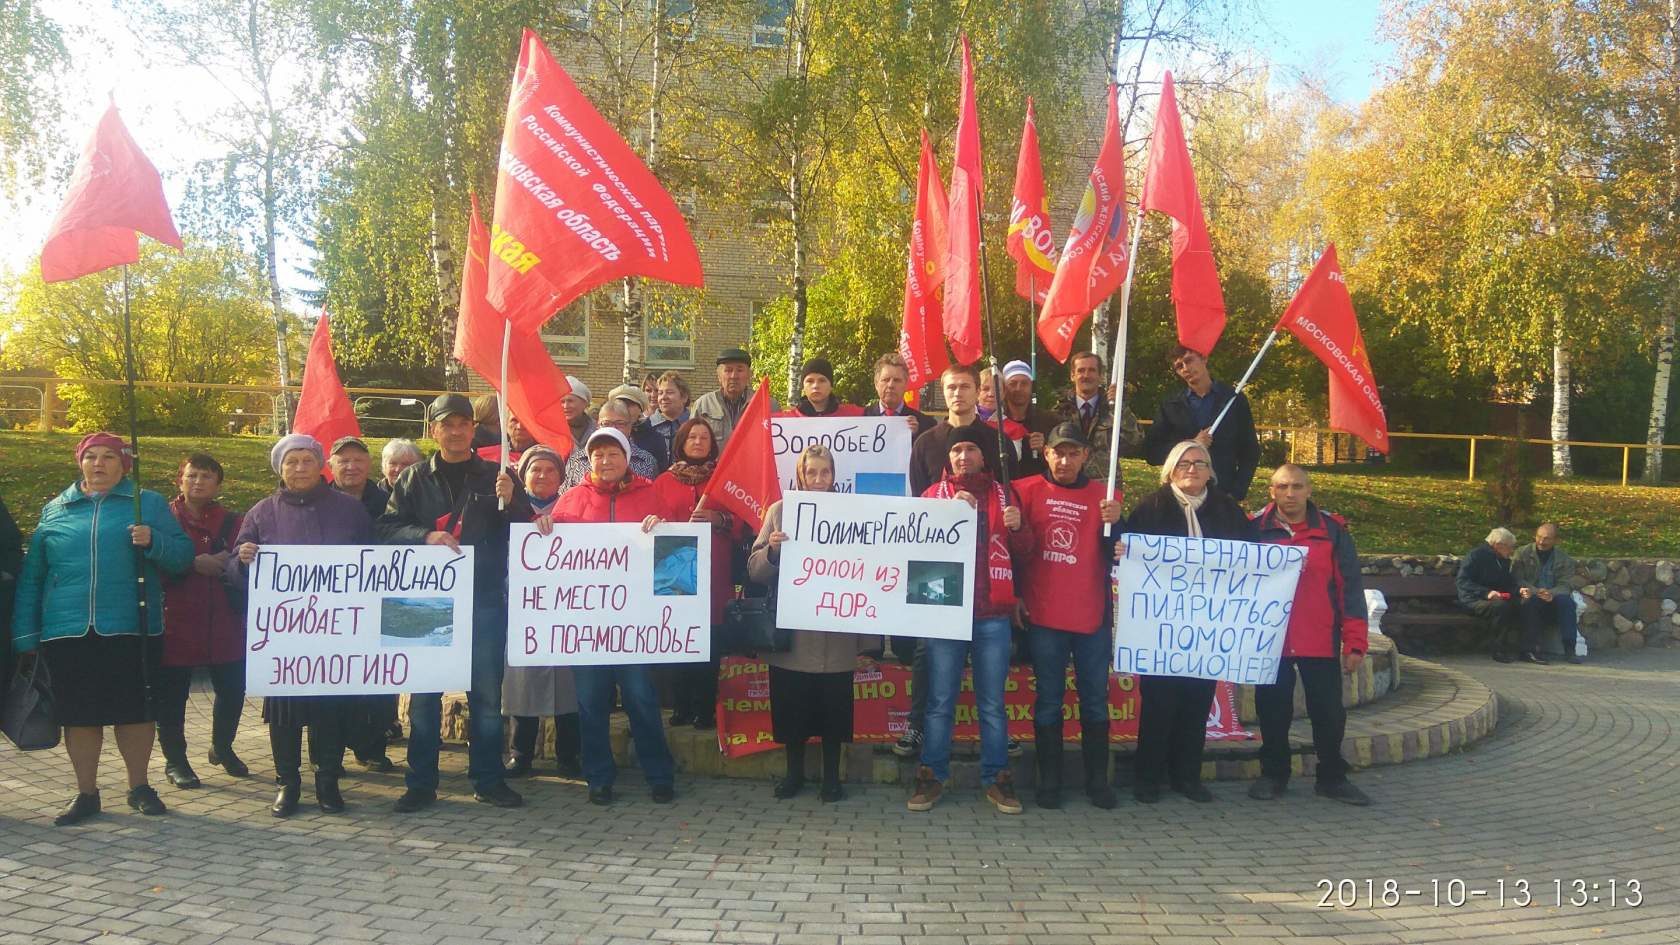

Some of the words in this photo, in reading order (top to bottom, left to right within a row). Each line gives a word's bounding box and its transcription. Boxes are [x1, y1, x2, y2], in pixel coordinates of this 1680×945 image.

[520, 114, 590, 178] Российской
[544, 104, 643, 209] Коммунистическая
[557, 208, 622, 262] область
[1296, 316, 1365, 384] МОСКОВСКАЯ
[1043, 550, 1077, 564] КПРФ
[1126, 534, 1303, 571] ГУБЕРНАТОР
[875, 566, 900, 591] из
[1142, 562, 1270, 596] ХВАТИТ
[554, 585, 627, 610] МЕСТО
[1131, 593, 1293, 627] ПИАРИТЬСЯ
[1159, 623, 1276, 654] ПОМОГИ
